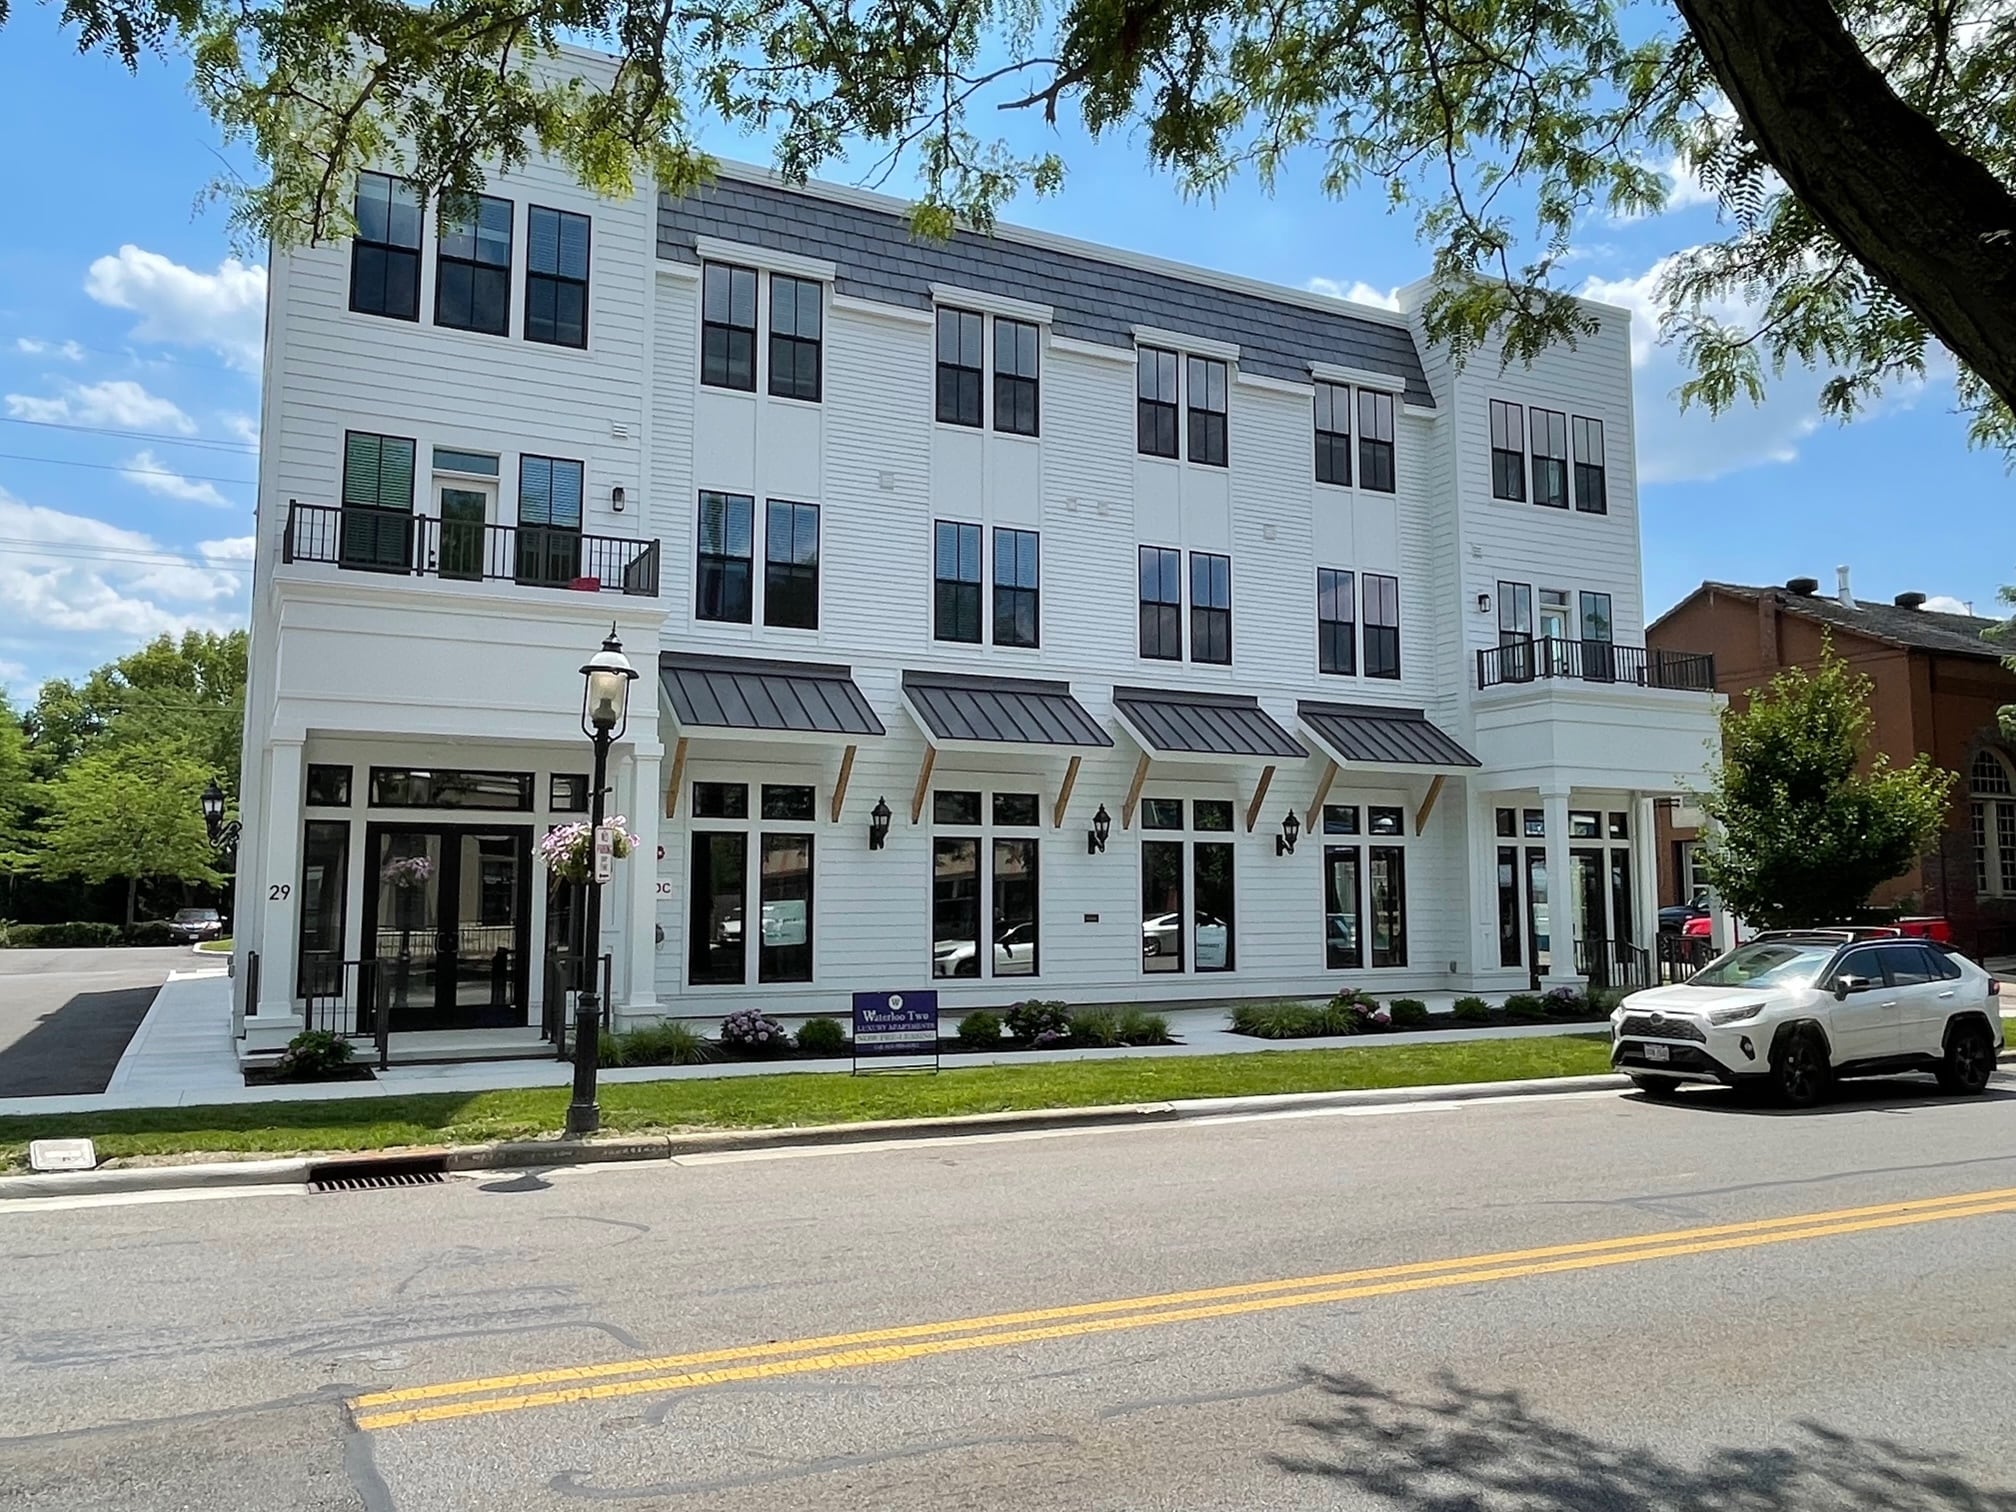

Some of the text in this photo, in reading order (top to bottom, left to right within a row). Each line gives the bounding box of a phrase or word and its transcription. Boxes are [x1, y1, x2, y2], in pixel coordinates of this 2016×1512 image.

[269, 884, 291, 900] 29
[862, 1010, 929, 1022] Waterloo Two
[857, 1024, 886, 1032] LUXURY
